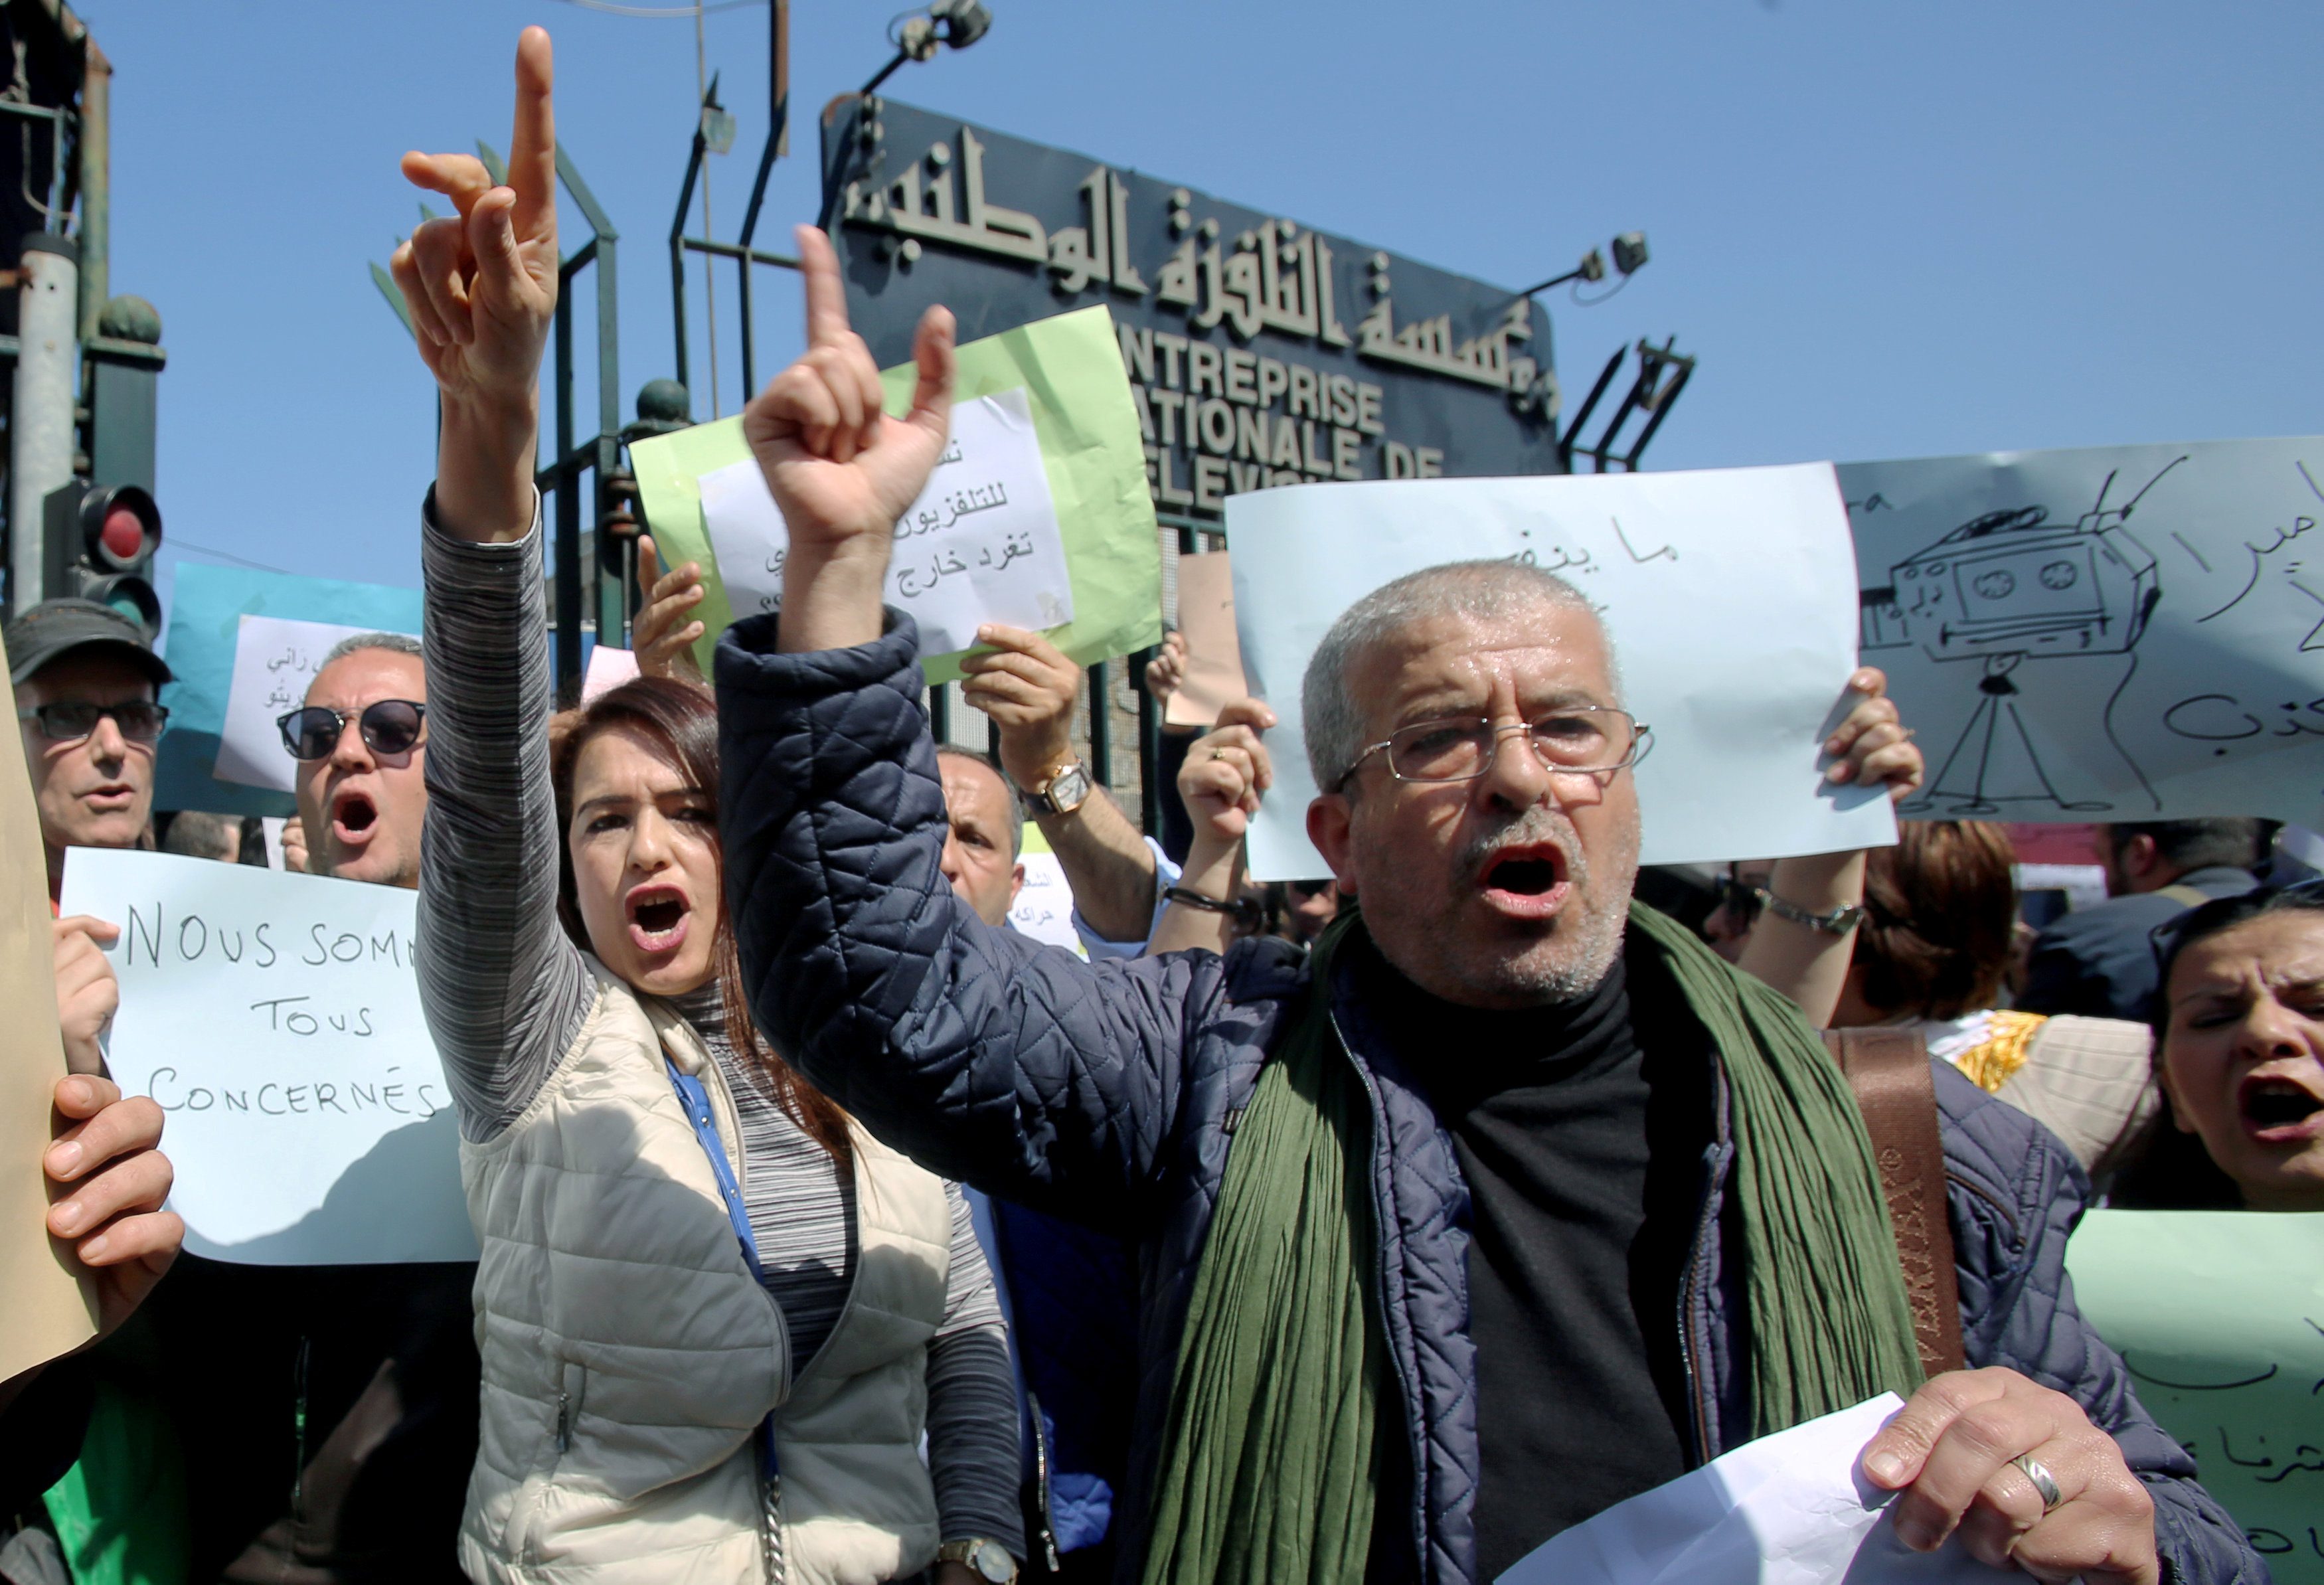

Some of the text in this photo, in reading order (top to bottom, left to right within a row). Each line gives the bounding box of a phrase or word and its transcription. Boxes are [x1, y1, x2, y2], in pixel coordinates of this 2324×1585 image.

[1156, 187, 1353, 349] التلفزة
[1118, 322, 1385, 437] NTREPRISE
[1385, 441, 1444, 479] DE
[896, 531, 1034, 598] تغرد خارج
[127, 902, 276, 968] NOUS
[250, 996, 373, 1037] TOUS
[149, 1065, 436, 1117] CONCERNÉS
